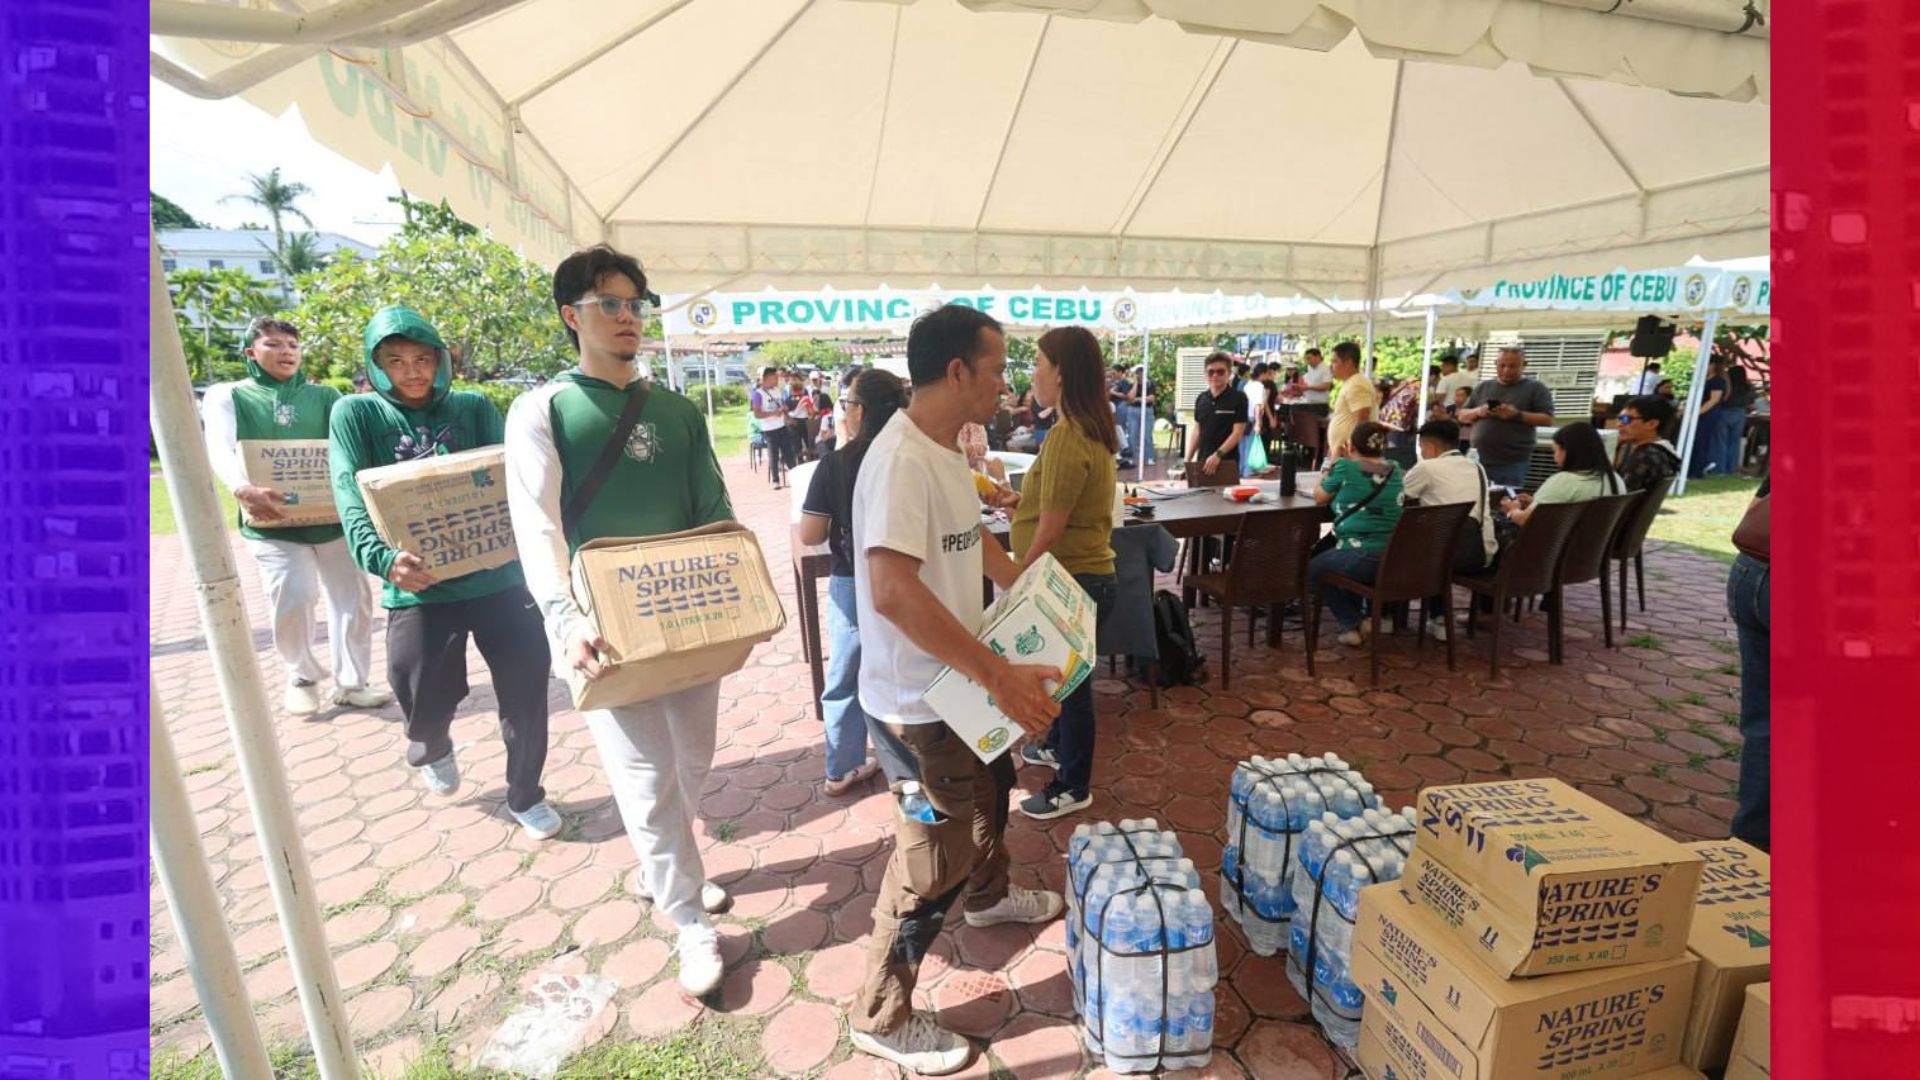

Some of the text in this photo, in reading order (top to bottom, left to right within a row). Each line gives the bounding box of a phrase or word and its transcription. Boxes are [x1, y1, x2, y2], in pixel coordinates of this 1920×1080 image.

[1495, 274, 1678, 301] PROVINCE OF CEBU
[732, 298, 917, 325] PROVINC
[1008, 296, 1101, 321] CEBU
[419, 516, 511, 553] SPRING
[618, 552, 740, 583] NATURE'S
[636, 570, 732, 598] SPRING
[1444, 795, 1558, 835] SPRING
[1420, 873, 1466, 914] SPRING
[1421, 860, 1480, 911] NATURE'S
[1378, 914, 1438, 968] NATURE'S
[1383, 928, 1428, 972] SPRING
[1536, 984, 1665, 1033] NATURE'S
[1545, 1009, 1647, 1049] SPRING
